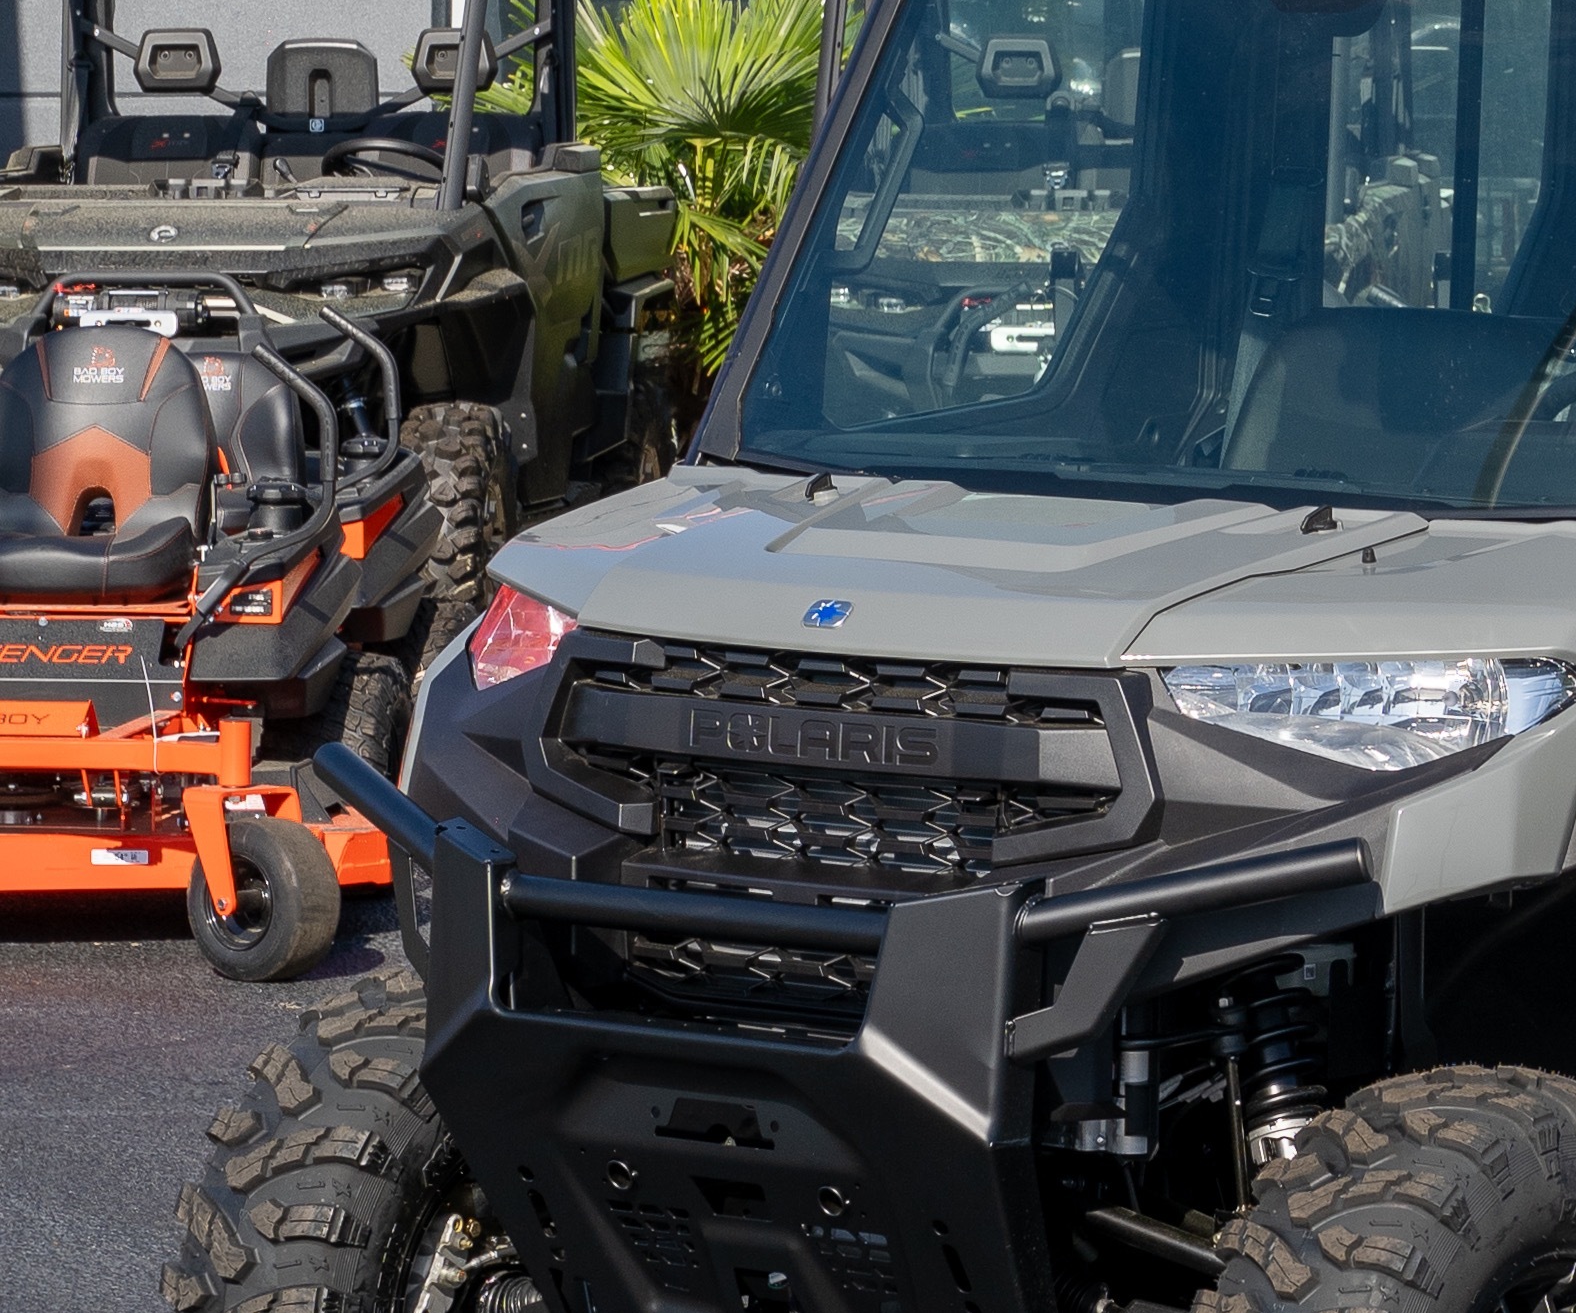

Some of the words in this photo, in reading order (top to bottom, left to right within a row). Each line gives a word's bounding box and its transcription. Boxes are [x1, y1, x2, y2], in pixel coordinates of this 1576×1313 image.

[73, 375, 124, 383] MOWERS
[0, 644, 133, 664] ENGER
[0, 713, 50, 724] OY
[690, 708, 940, 766] POLARIS
